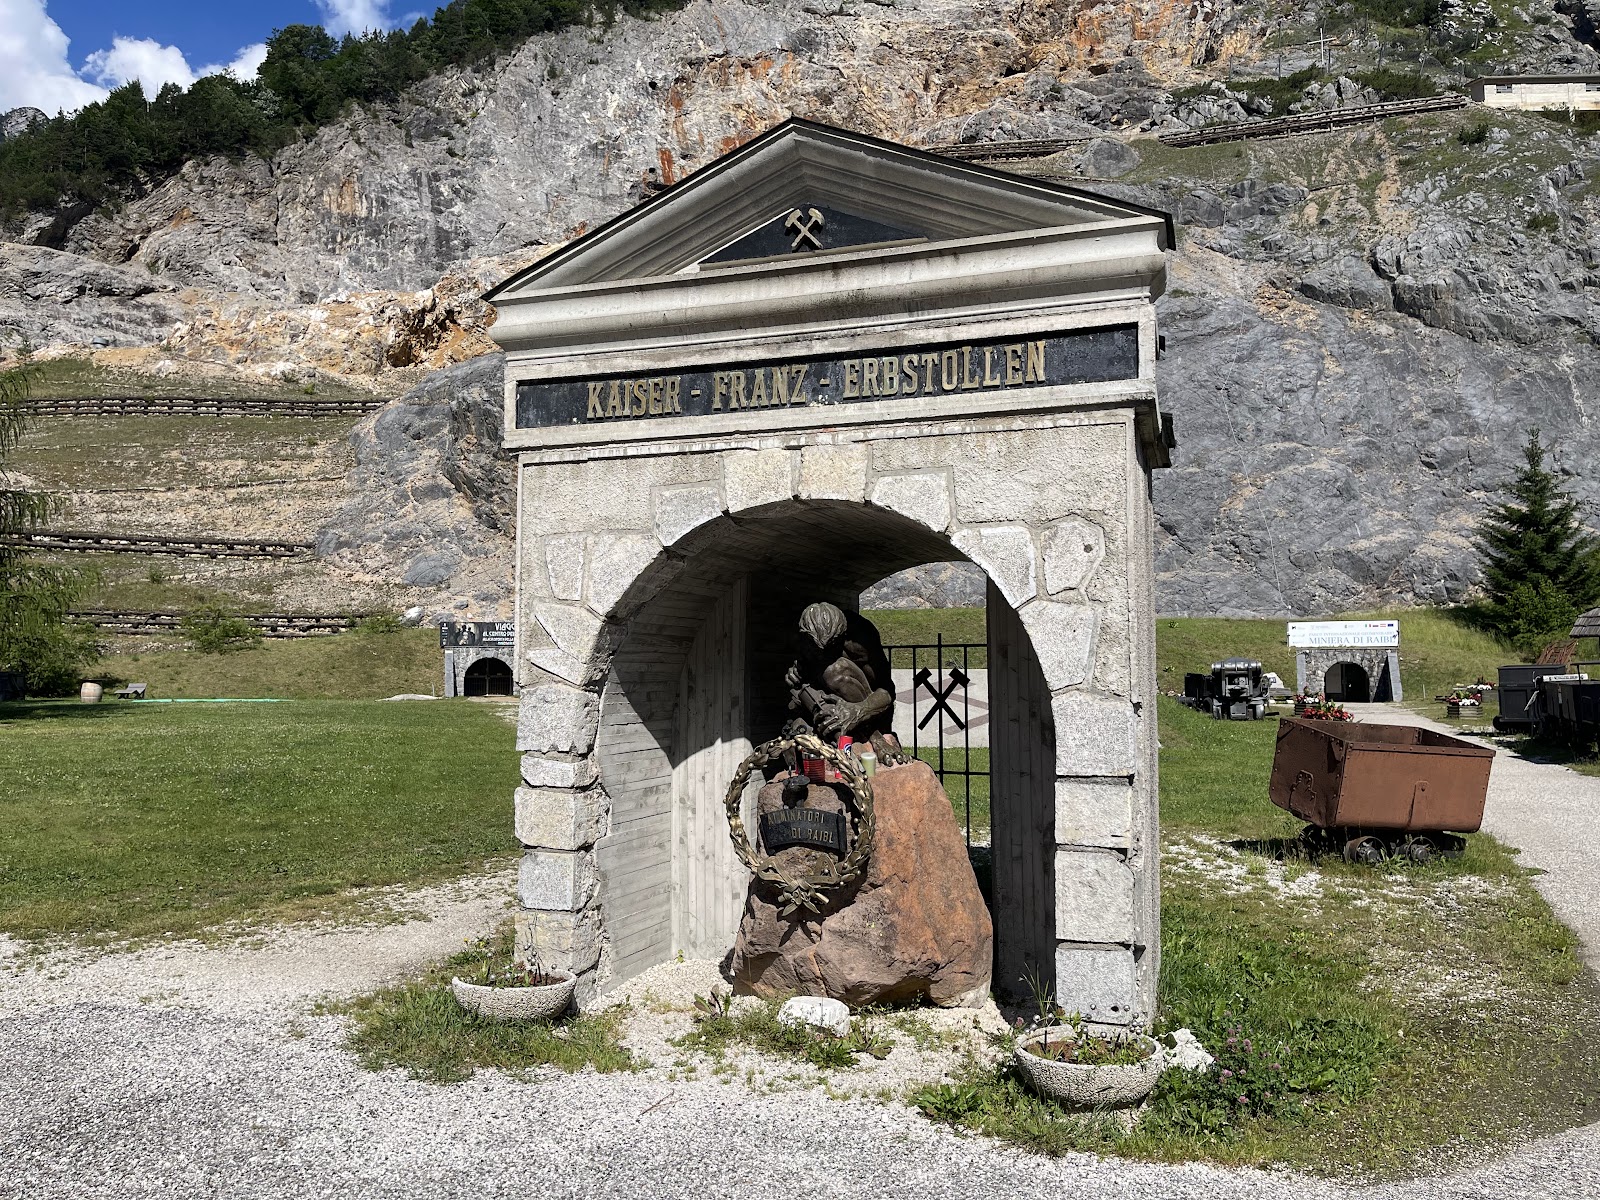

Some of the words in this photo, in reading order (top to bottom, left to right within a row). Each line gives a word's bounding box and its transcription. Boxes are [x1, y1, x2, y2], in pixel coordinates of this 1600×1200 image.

[587, 375, 682, 419] KAISER
[712, 364, 808, 410] FRANZ
[843, 340, 1046, 398] ERBSTOLLEN
[1309, 636, 1350, 645] MINIERA
[1353, 636, 1364, 644] DI
[1366, 635, 1396, 644] RAIBL
[782, 809, 824, 824] MINATORI
[791, 827, 801, 839] DI
[808, 828, 834, 843] RAIBL
